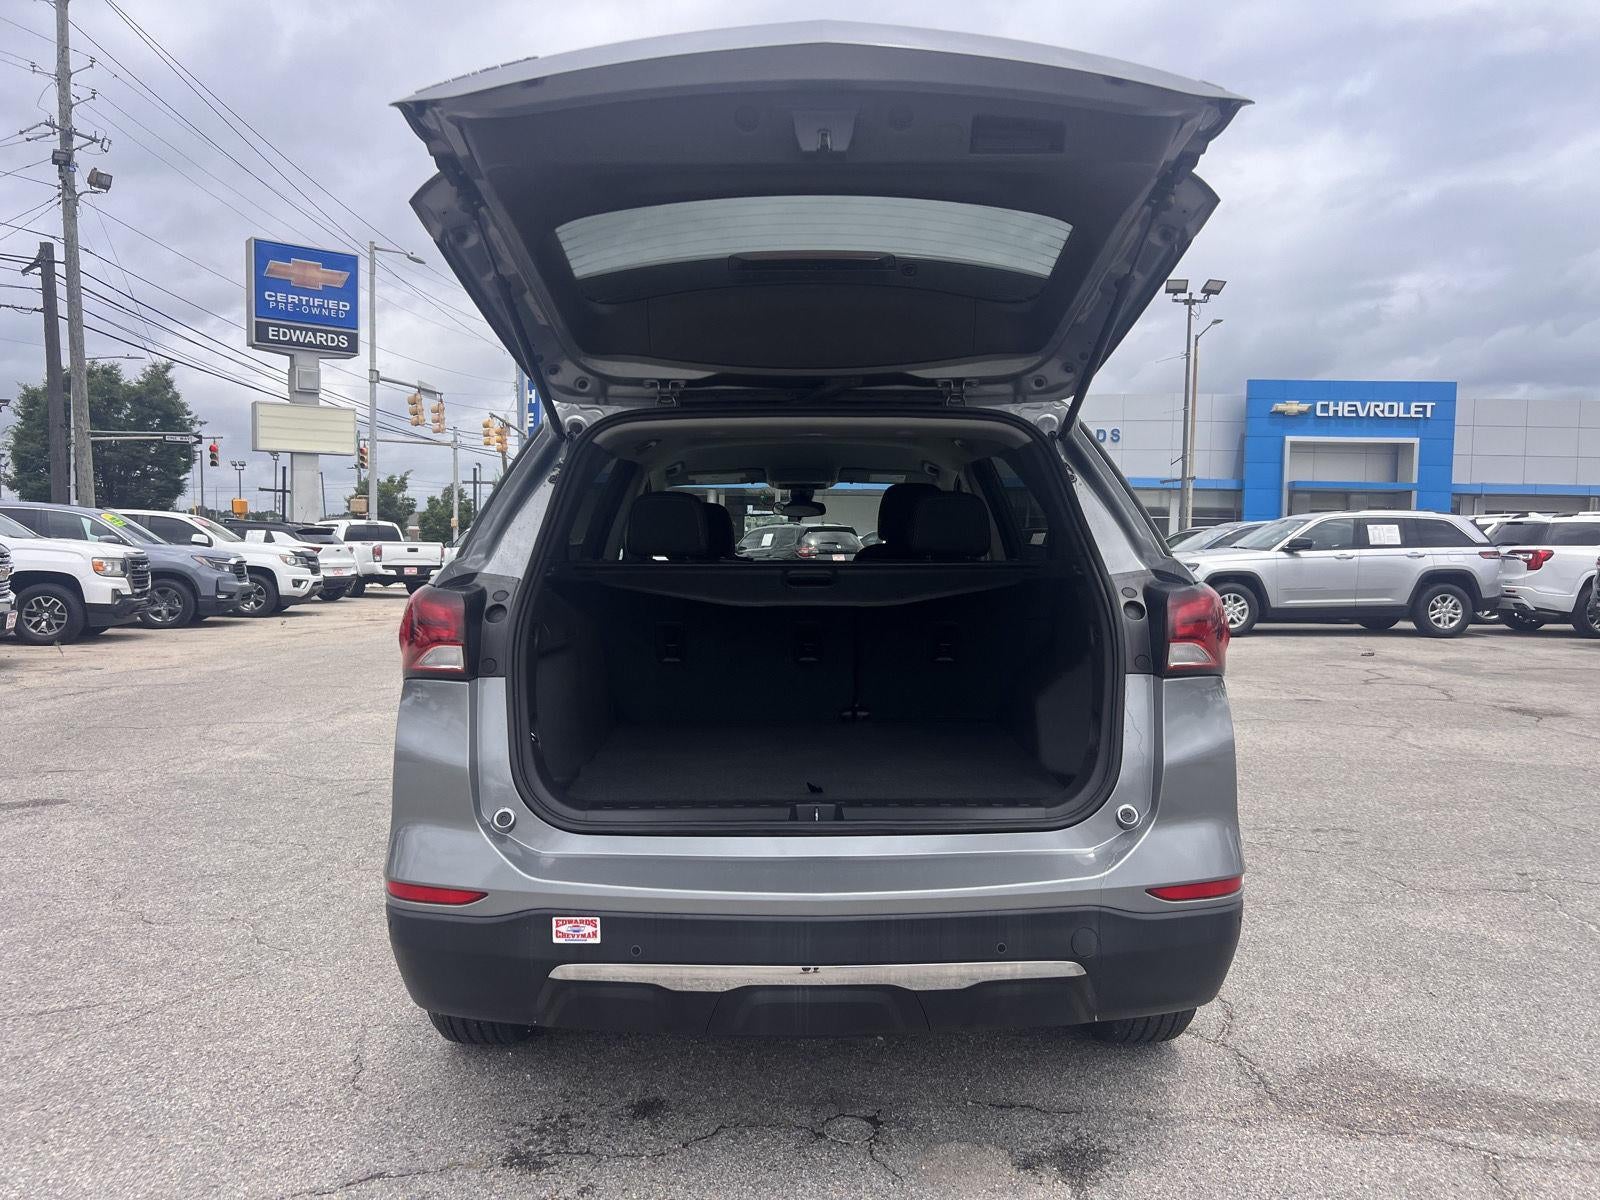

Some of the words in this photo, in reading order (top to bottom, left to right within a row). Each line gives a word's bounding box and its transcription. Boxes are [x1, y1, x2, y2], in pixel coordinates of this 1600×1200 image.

[264, 291, 350, 311] CERTIFIED
[269, 301, 346, 319] PRE-OWNED
[268, 326, 349, 348] EDWARDS
[1315, 401, 1436, 418] CHEVROLET
[554, 919, 598, 929] EDWARDS
[555, 929, 598, 939] CHEVYMAN
